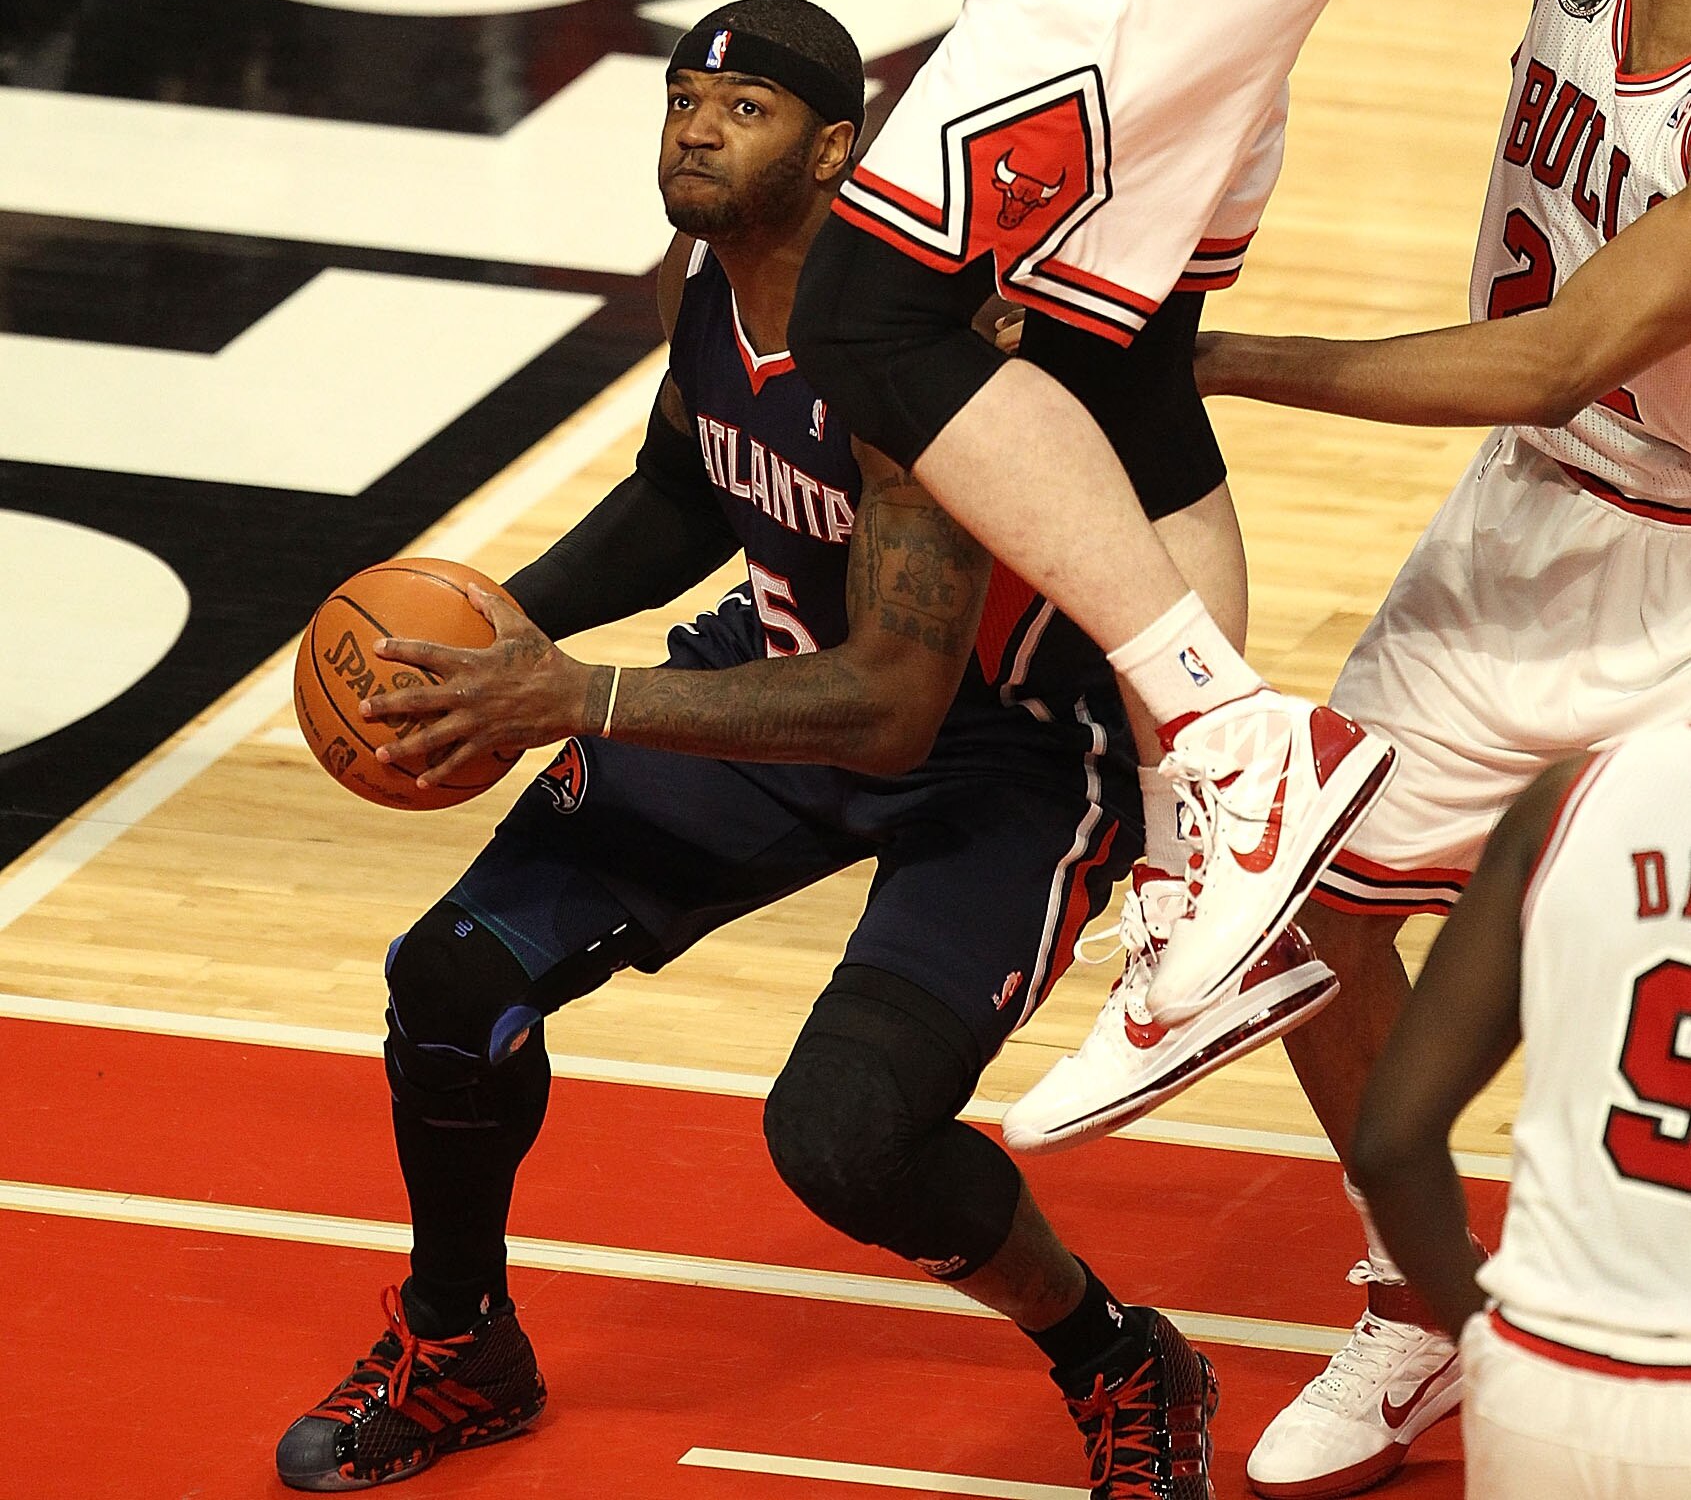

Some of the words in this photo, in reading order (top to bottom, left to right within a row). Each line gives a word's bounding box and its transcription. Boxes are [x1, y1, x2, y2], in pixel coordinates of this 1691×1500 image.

[1503, 56, 1668, 243] BULL
[696, 413, 856, 544] ATLANTA
[747, 558, 821, 659] 5
